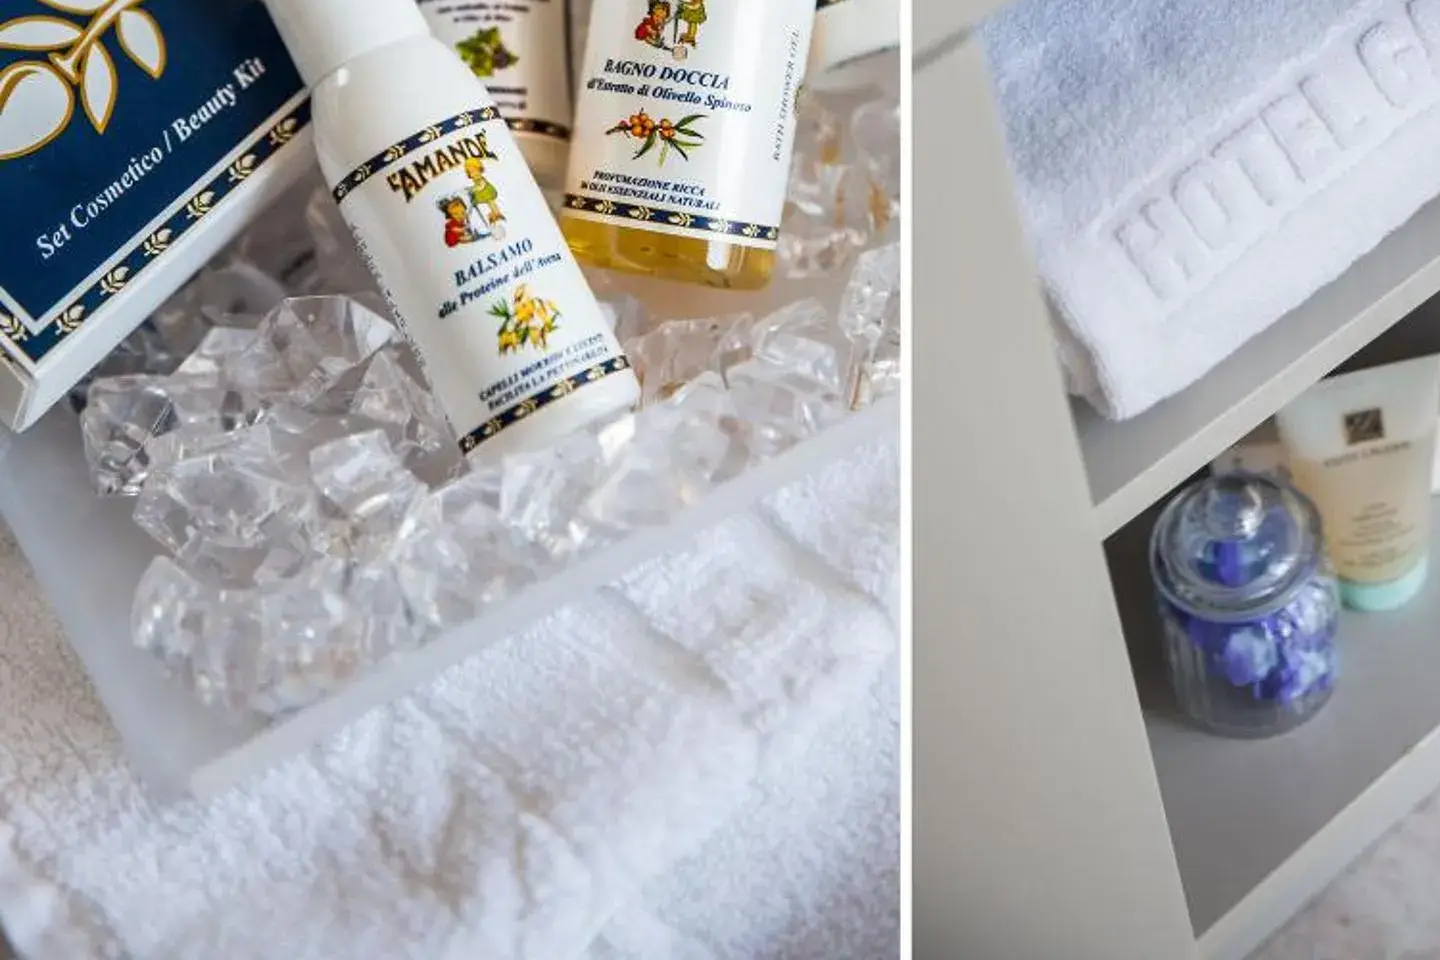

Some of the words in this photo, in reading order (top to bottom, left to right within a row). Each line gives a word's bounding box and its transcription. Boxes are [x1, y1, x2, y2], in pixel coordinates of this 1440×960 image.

[604, 59, 656, 78] BAGNO
[660, 66, 730, 90] DOCCIA
[637, 84, 650, 97] di
[652, 86, 701, 104] Olivello
[704, 94, 751, 113] Spinoso
[35, 221, 72, 261] Set
[68, 149, 163, 229] Cosmetico
[172, 81, 239, 145] Beauty
[233, 55, 267, 95] Kit
[1113, 75, 1368, 300] HOTEL
[454, 237, 533, 288] BALSAMO
[460, 273, 510, 306] Proteine
